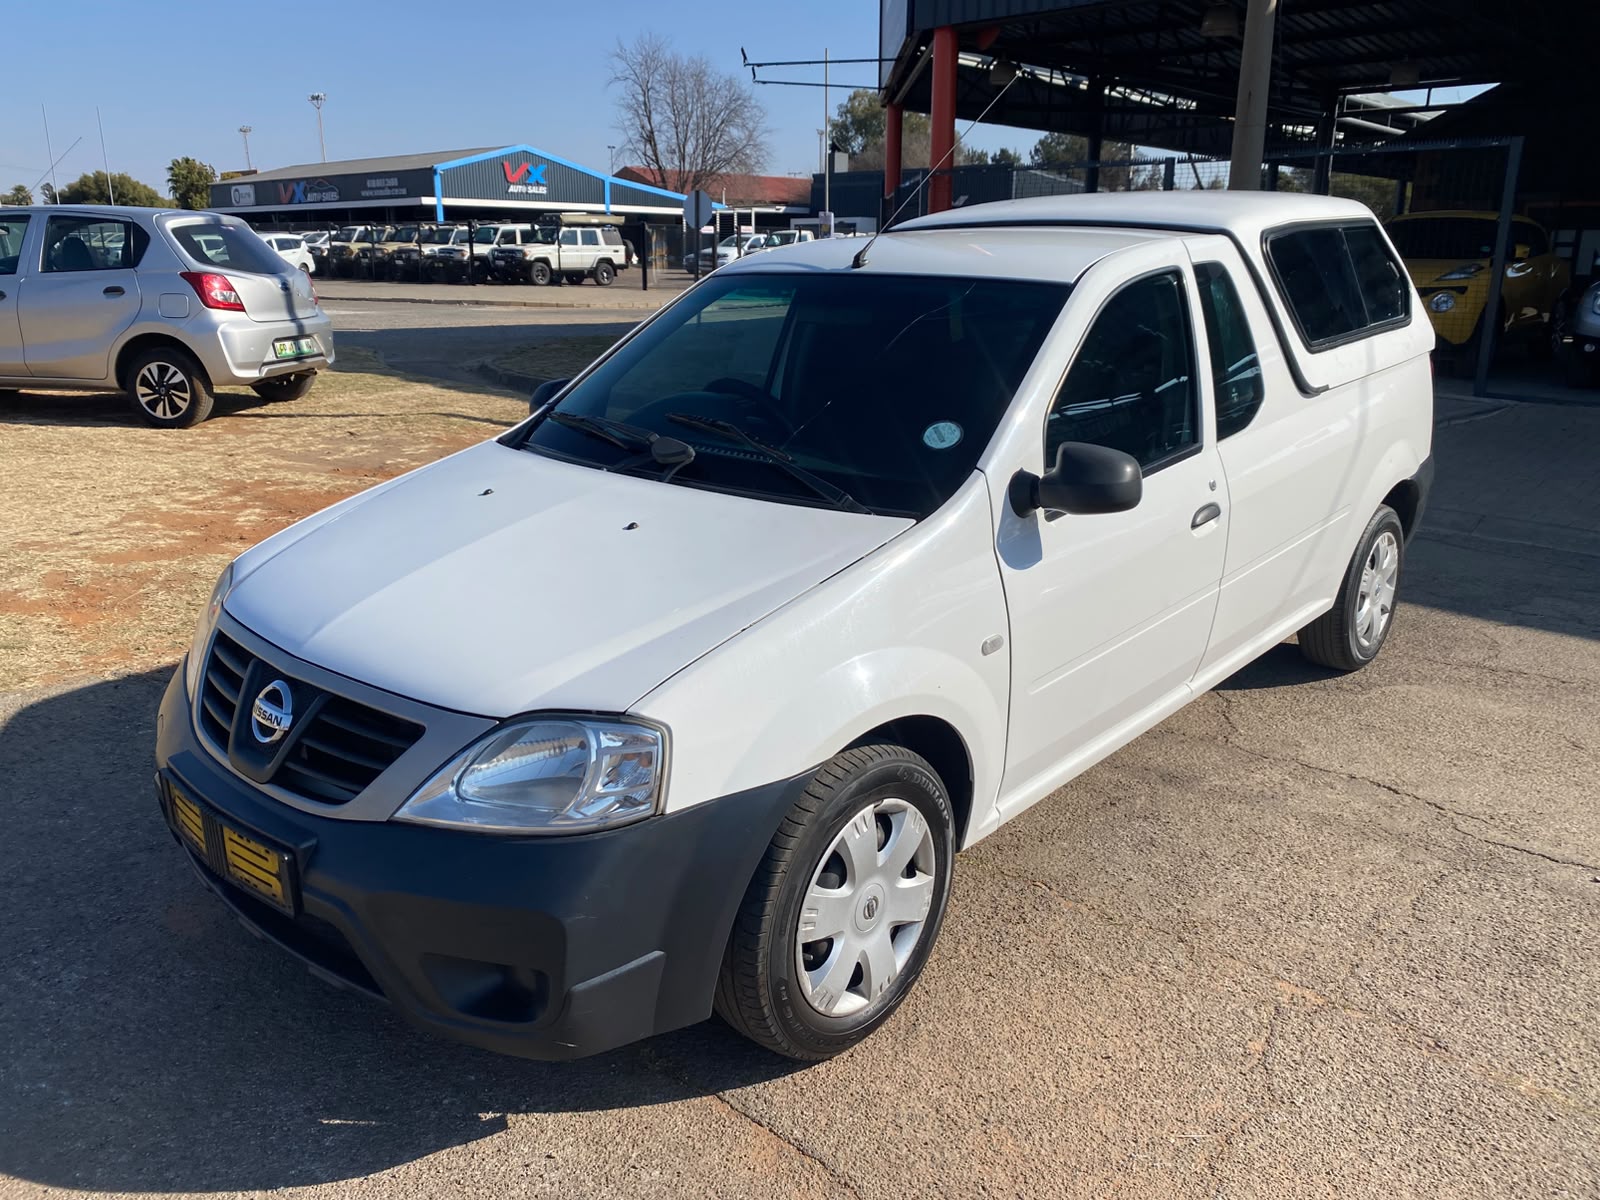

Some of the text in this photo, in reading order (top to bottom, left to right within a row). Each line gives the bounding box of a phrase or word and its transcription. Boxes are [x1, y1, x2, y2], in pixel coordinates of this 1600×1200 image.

[503, 161, 547, 184] VX
[279, 181, 306, 204] VX
[307, 191, 339, 202] AUTO SALES
[508, 185, 547, 194] AUTO SALES
[253, 702, 283, 726] NISSAN
[912, 772, 950, 820] DUNLOP
